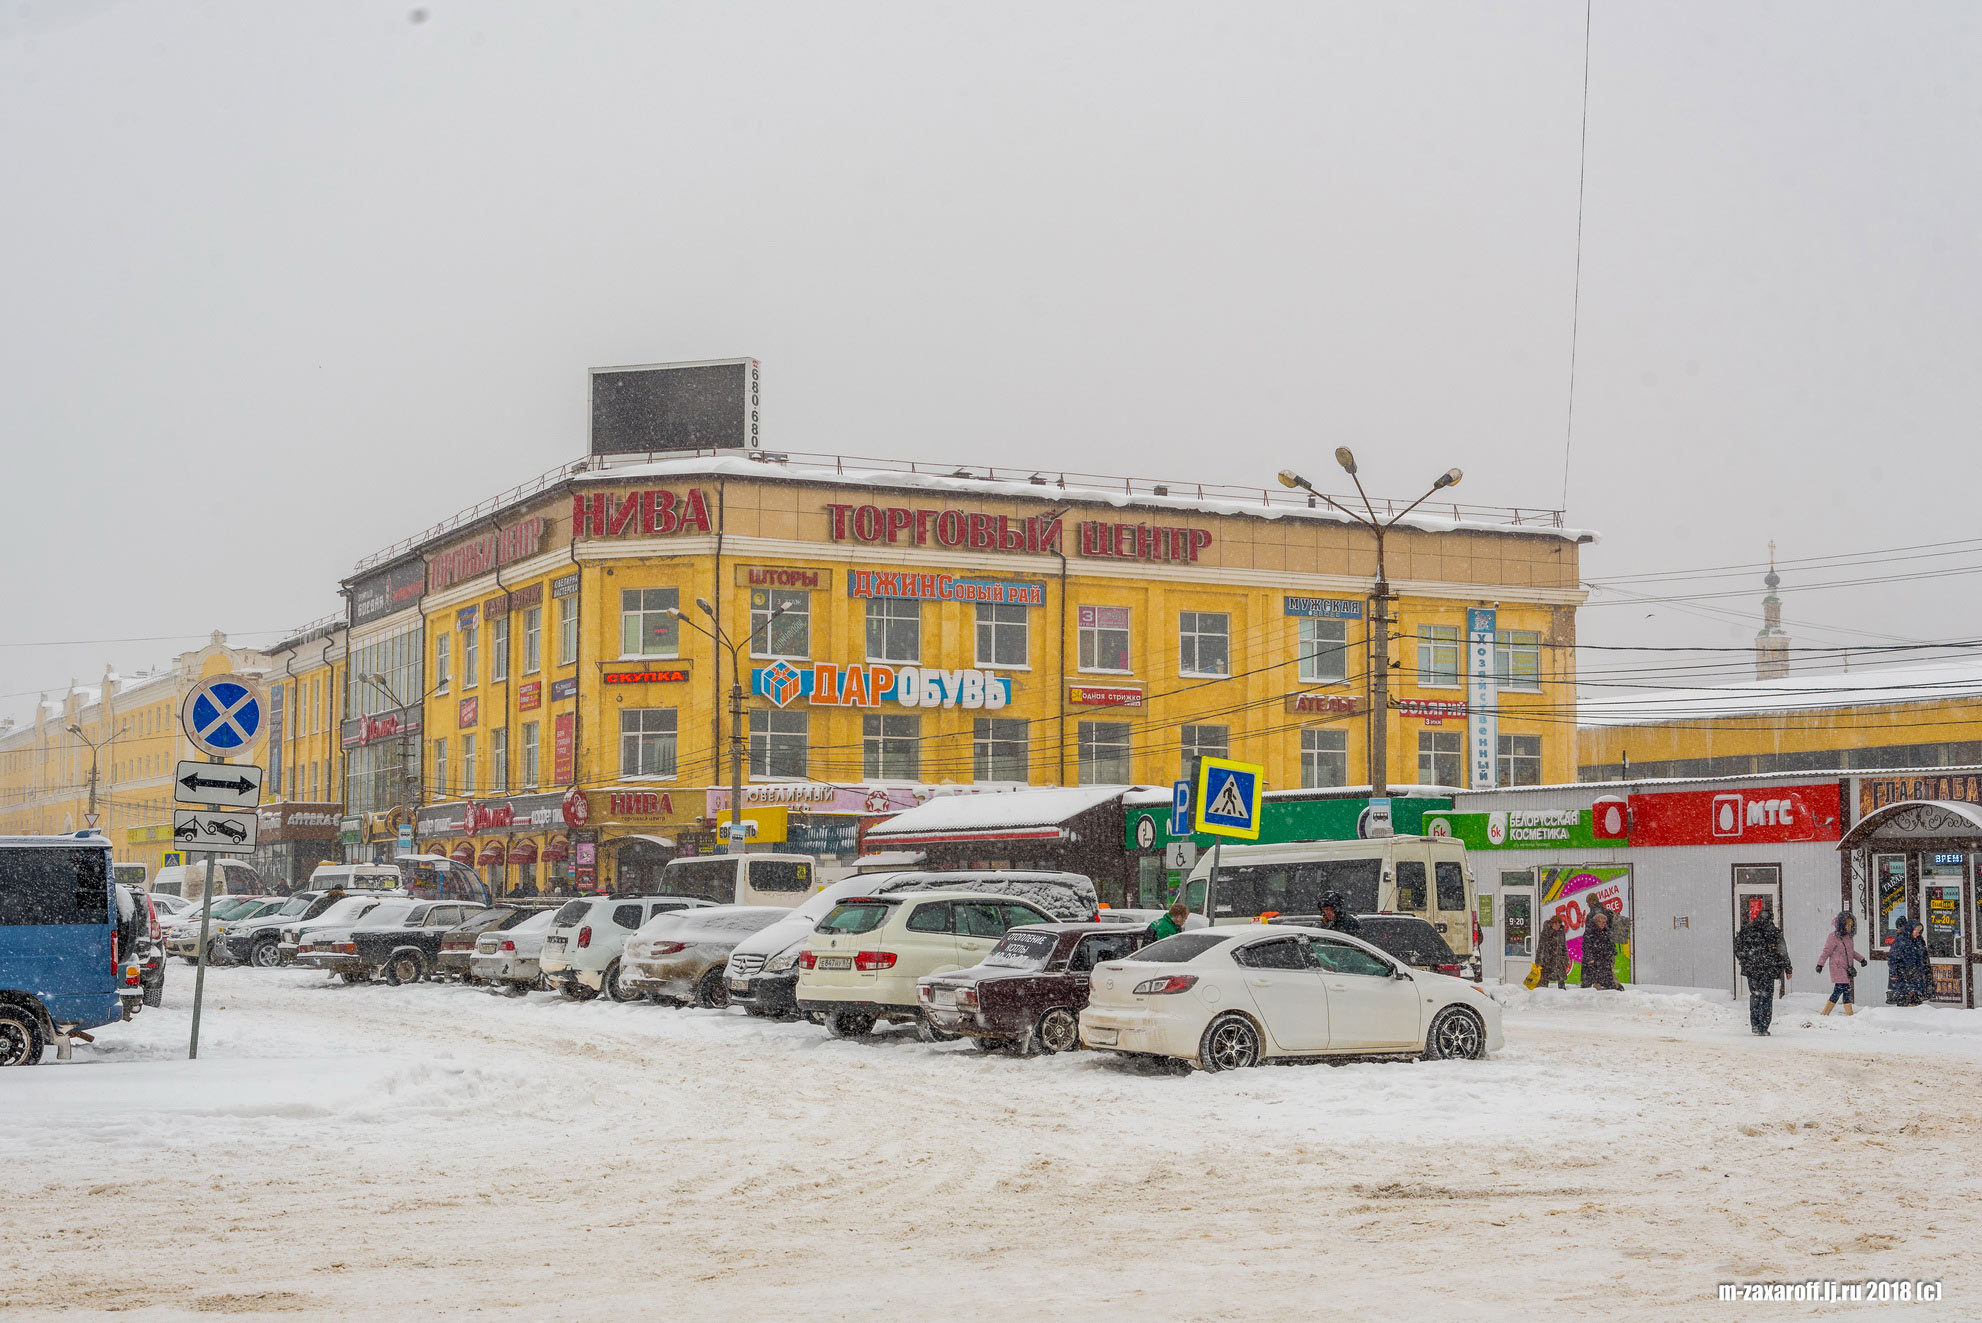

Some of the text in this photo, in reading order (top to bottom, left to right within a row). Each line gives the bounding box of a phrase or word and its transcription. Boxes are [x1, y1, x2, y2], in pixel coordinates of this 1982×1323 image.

[572, 488, 712, 537] НИВА
[827, 503, 1213, 562] ТОРГОВЫЙ ЦЕНТР
[749, 568, 818, 587] ШТОРЫ
[1008, 585, 1042, 604] РАЙ
[1289, 598, 1360, 614] МУЖСКАЯ
[606, 671, 685, 683] СКУПКА
[809, 661, 1006, 710] ДАР ОБУВЬ
[1108, 694, 1141, 703] стрижка
[1296, 695, 1358, 713] АТЕЛЬЕ
[1399, 700, 1467, 716] СОЛЯРИЙ
[745, 787, 835, 802] ЮВЕЛИРНЫЙ
[610, 792, 675, 815] НИВА
[1175, 783, 1190, 832] P
[1509, 811, 1579, 828] БЕЛОРУССКАЯ
[1746, 799, 1794, 826] МТС
[1509, 827, 1570, 841] КОСМЕТИКА
[1007, 932, 1048, 945] ОТОПЛЕНИЕ
[1004, 943, 1030, 955] КОТЛЫ
